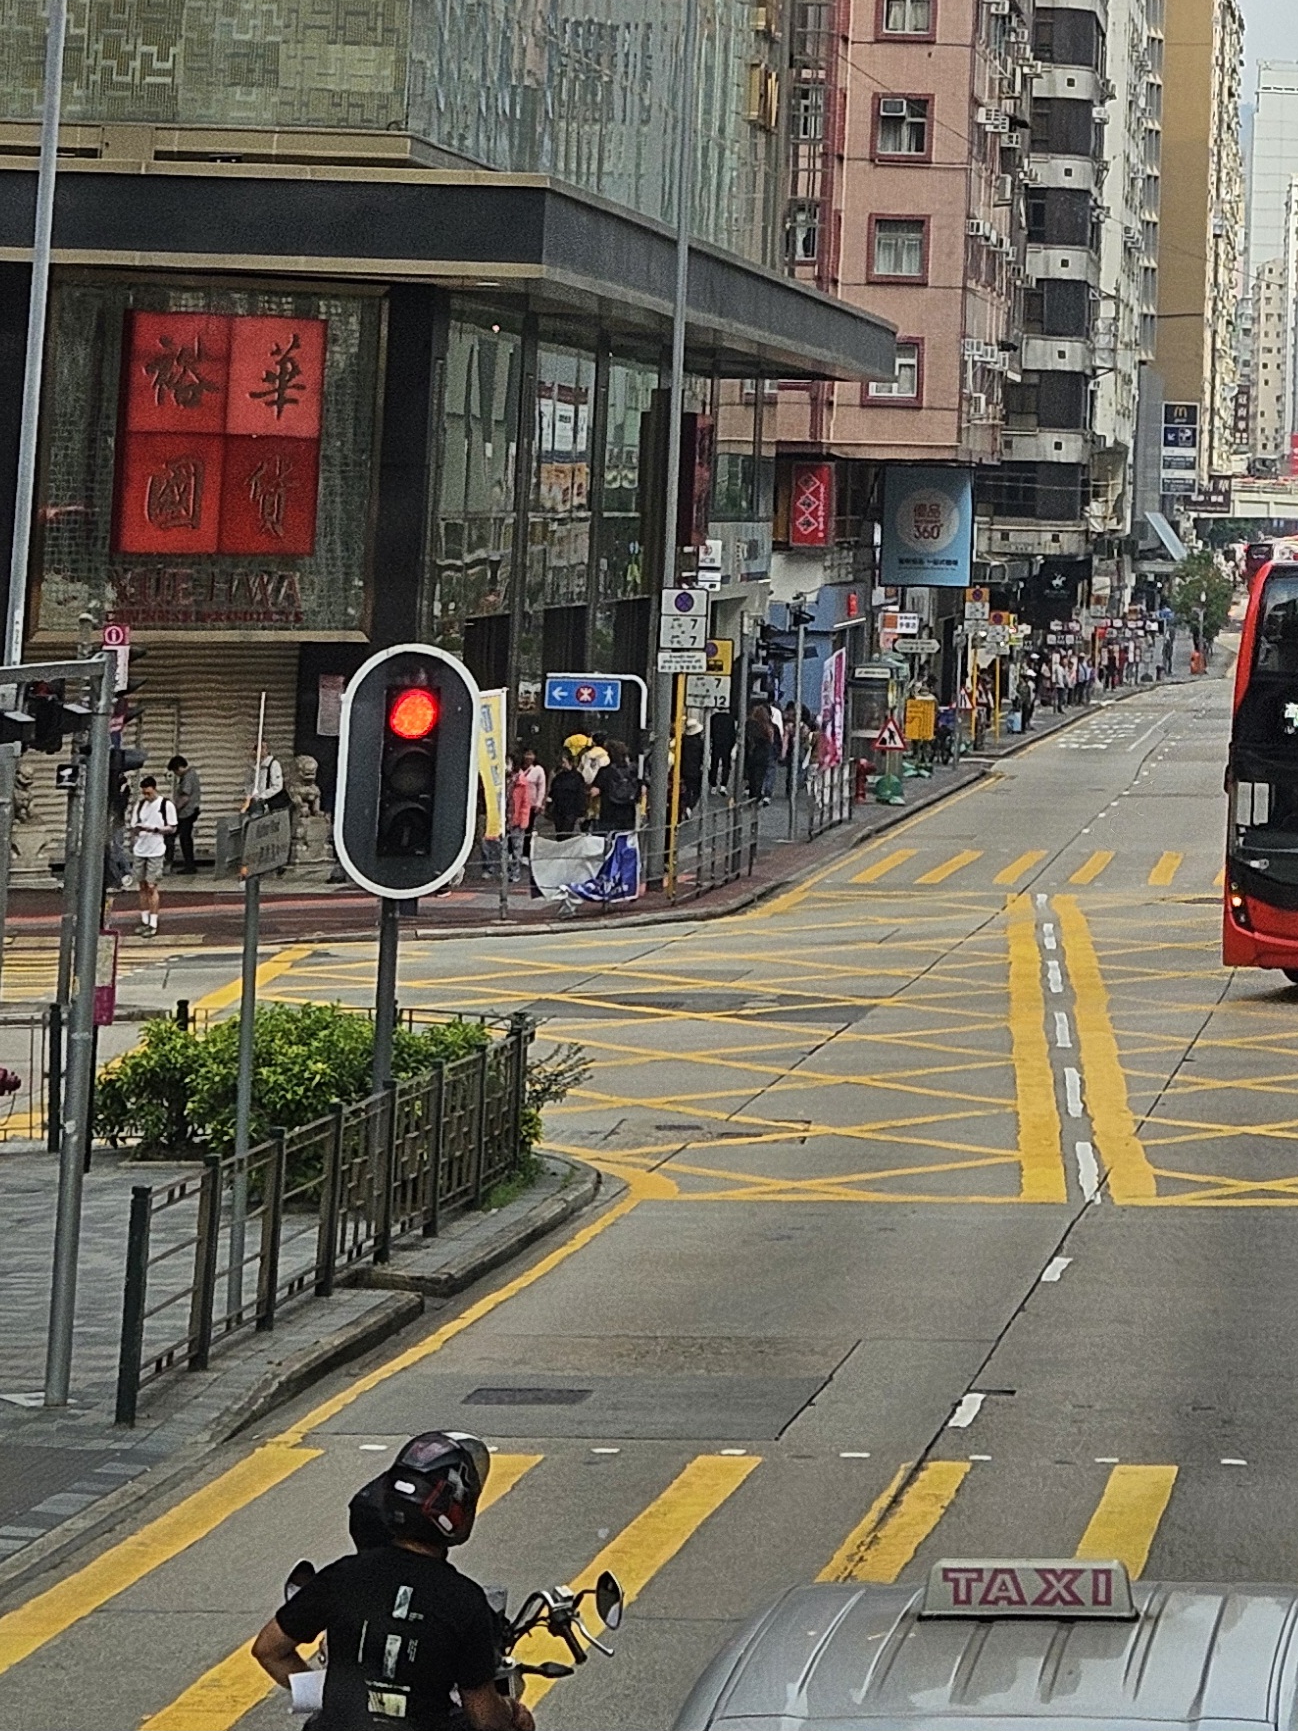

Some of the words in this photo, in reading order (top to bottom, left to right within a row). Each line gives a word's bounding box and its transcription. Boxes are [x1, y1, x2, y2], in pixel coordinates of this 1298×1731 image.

[141, 331, 307, 420] 裕華
[144, 452, 295, 540] 國貨
[690, 619, 698, 630] 7
[689, 636, 697, 647] 7
[714, 678, 722, 689] 7
[714, 696, 727, 707] 12
[942, 1567, 1113, 1607] TAXI
